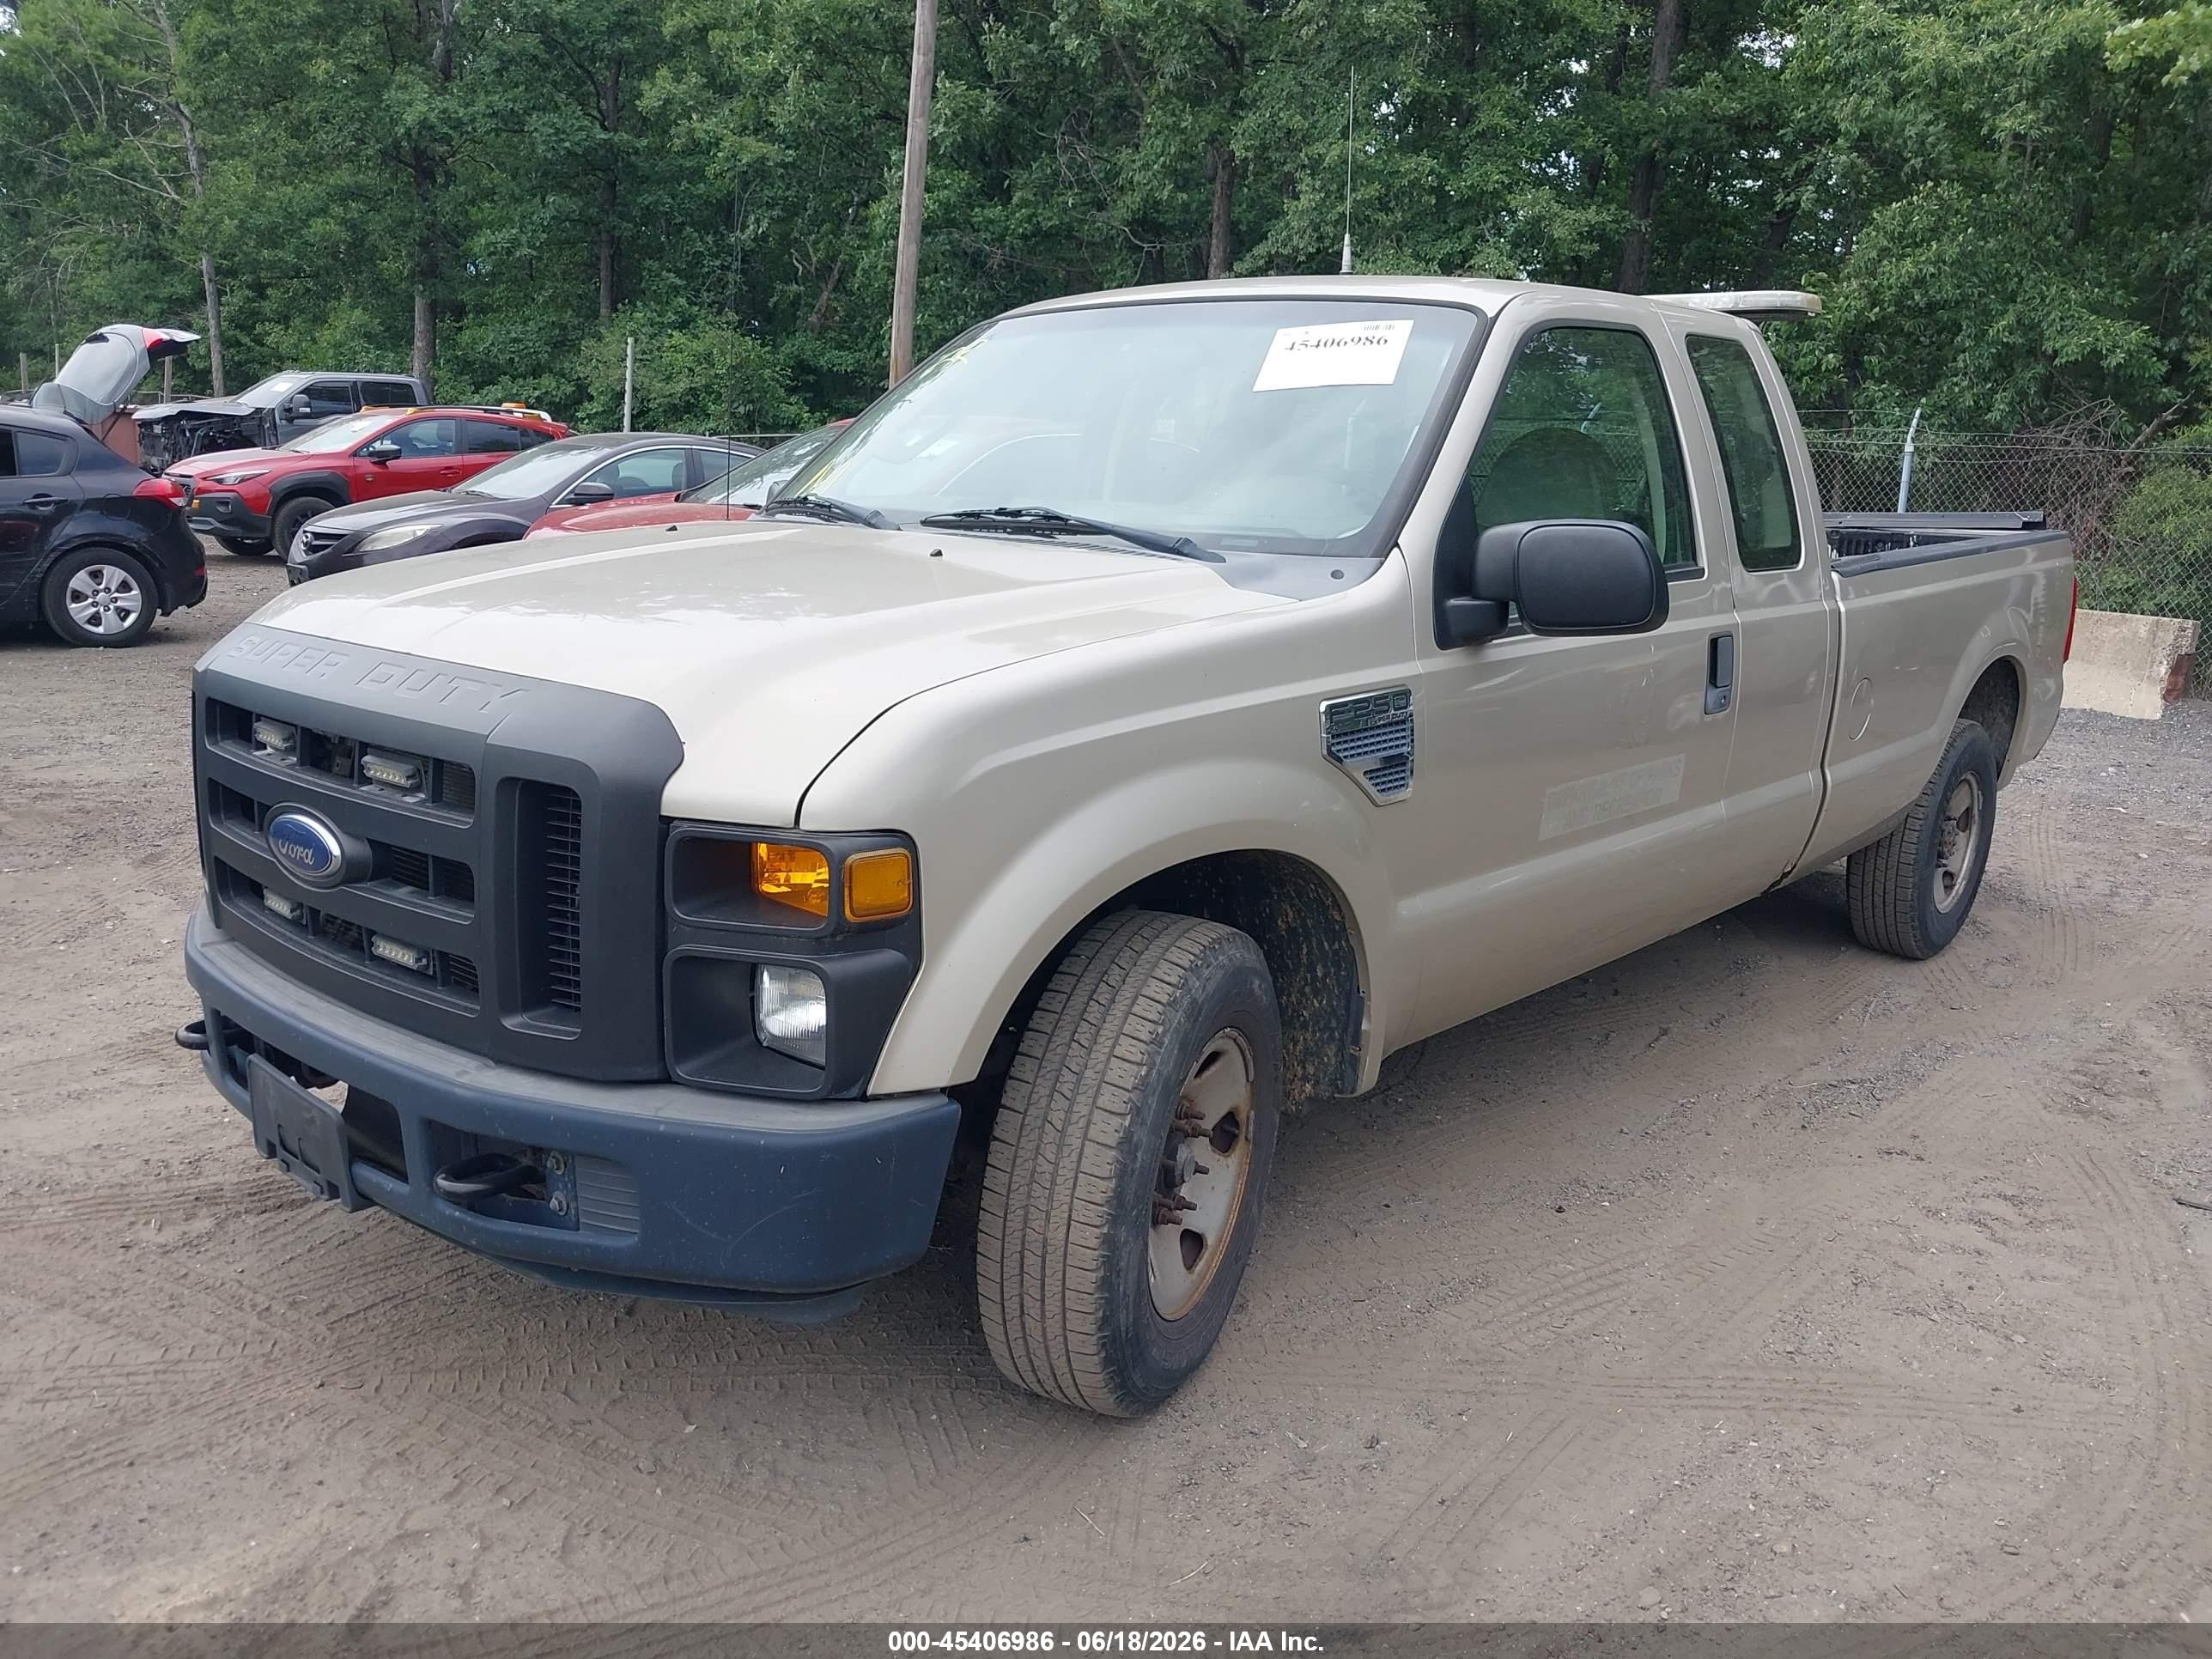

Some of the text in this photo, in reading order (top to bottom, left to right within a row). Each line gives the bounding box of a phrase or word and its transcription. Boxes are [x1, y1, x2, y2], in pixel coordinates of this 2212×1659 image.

[1285, 335, 1389, 351] 45406986
[227, 635, 531, 715] SUPER DUTY
[277, 823, 316, 866] Ford
